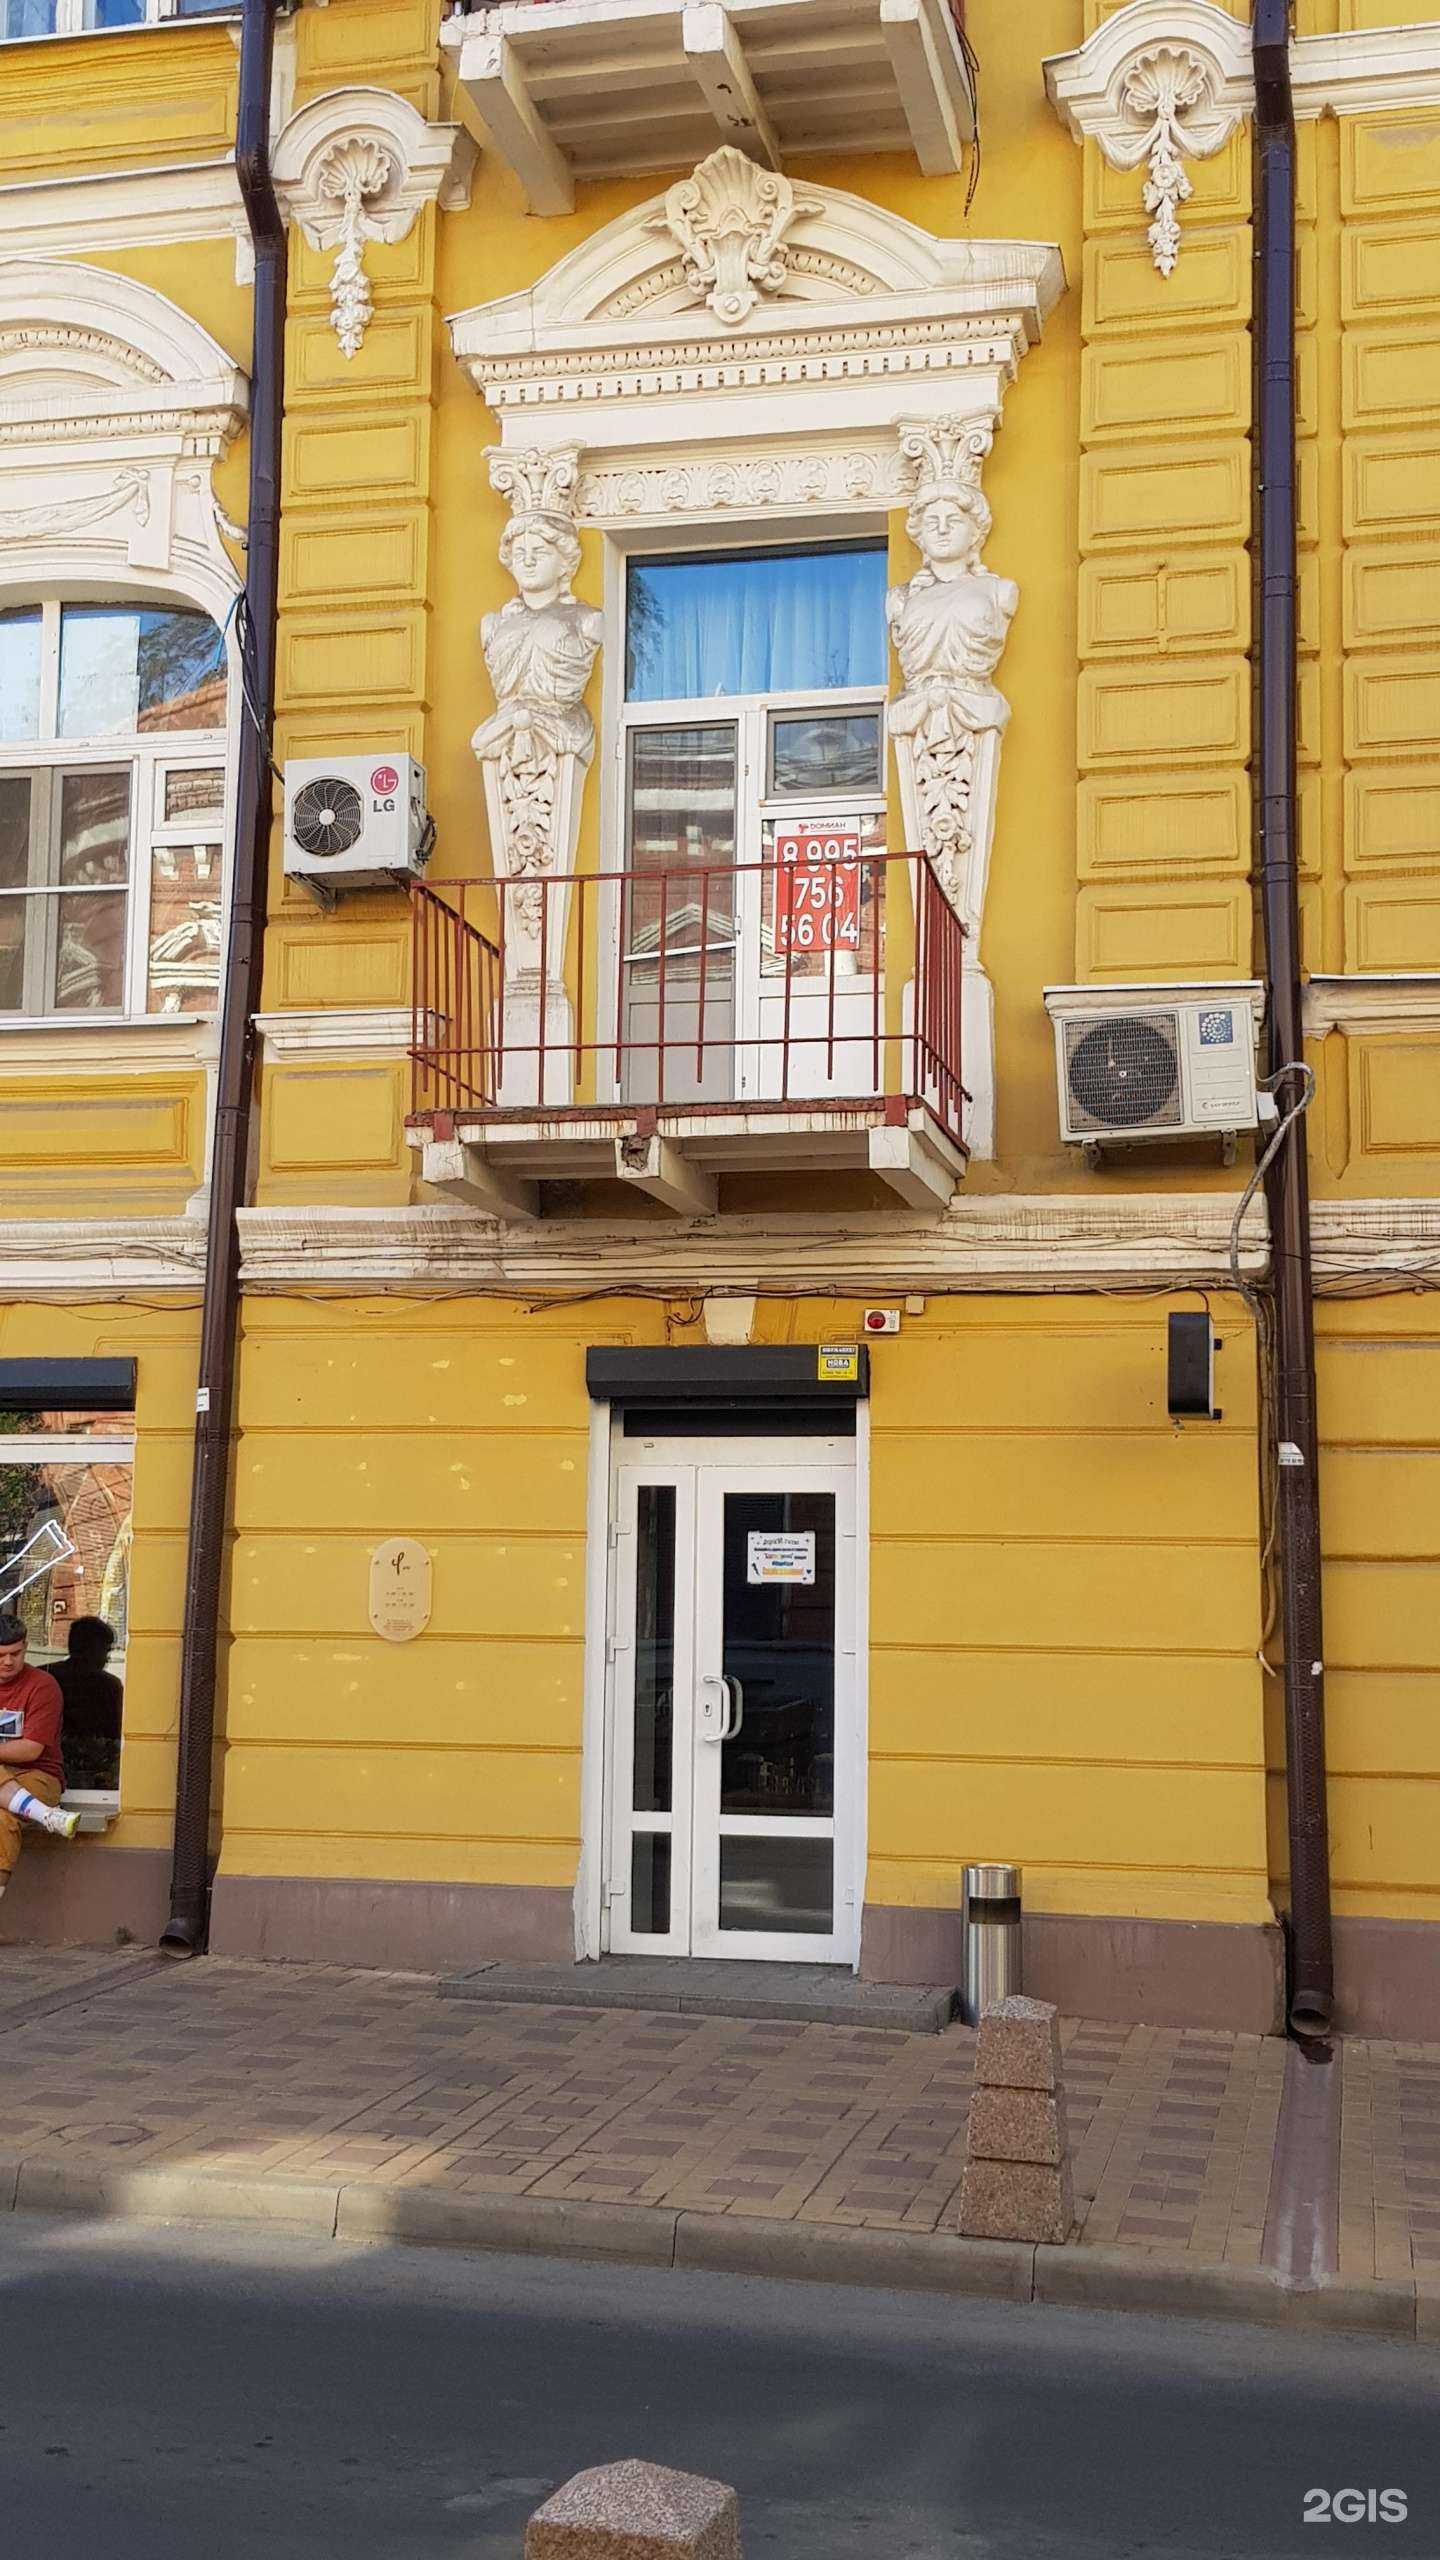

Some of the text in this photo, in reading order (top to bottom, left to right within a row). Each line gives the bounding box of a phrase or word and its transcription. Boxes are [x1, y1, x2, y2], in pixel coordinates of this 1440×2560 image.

[373, 800, 395, 813] LG
[783, 841, 798, 873] 8
[794, 876, 844, 908] 756
[781, 912, 857, 946] 56 04
